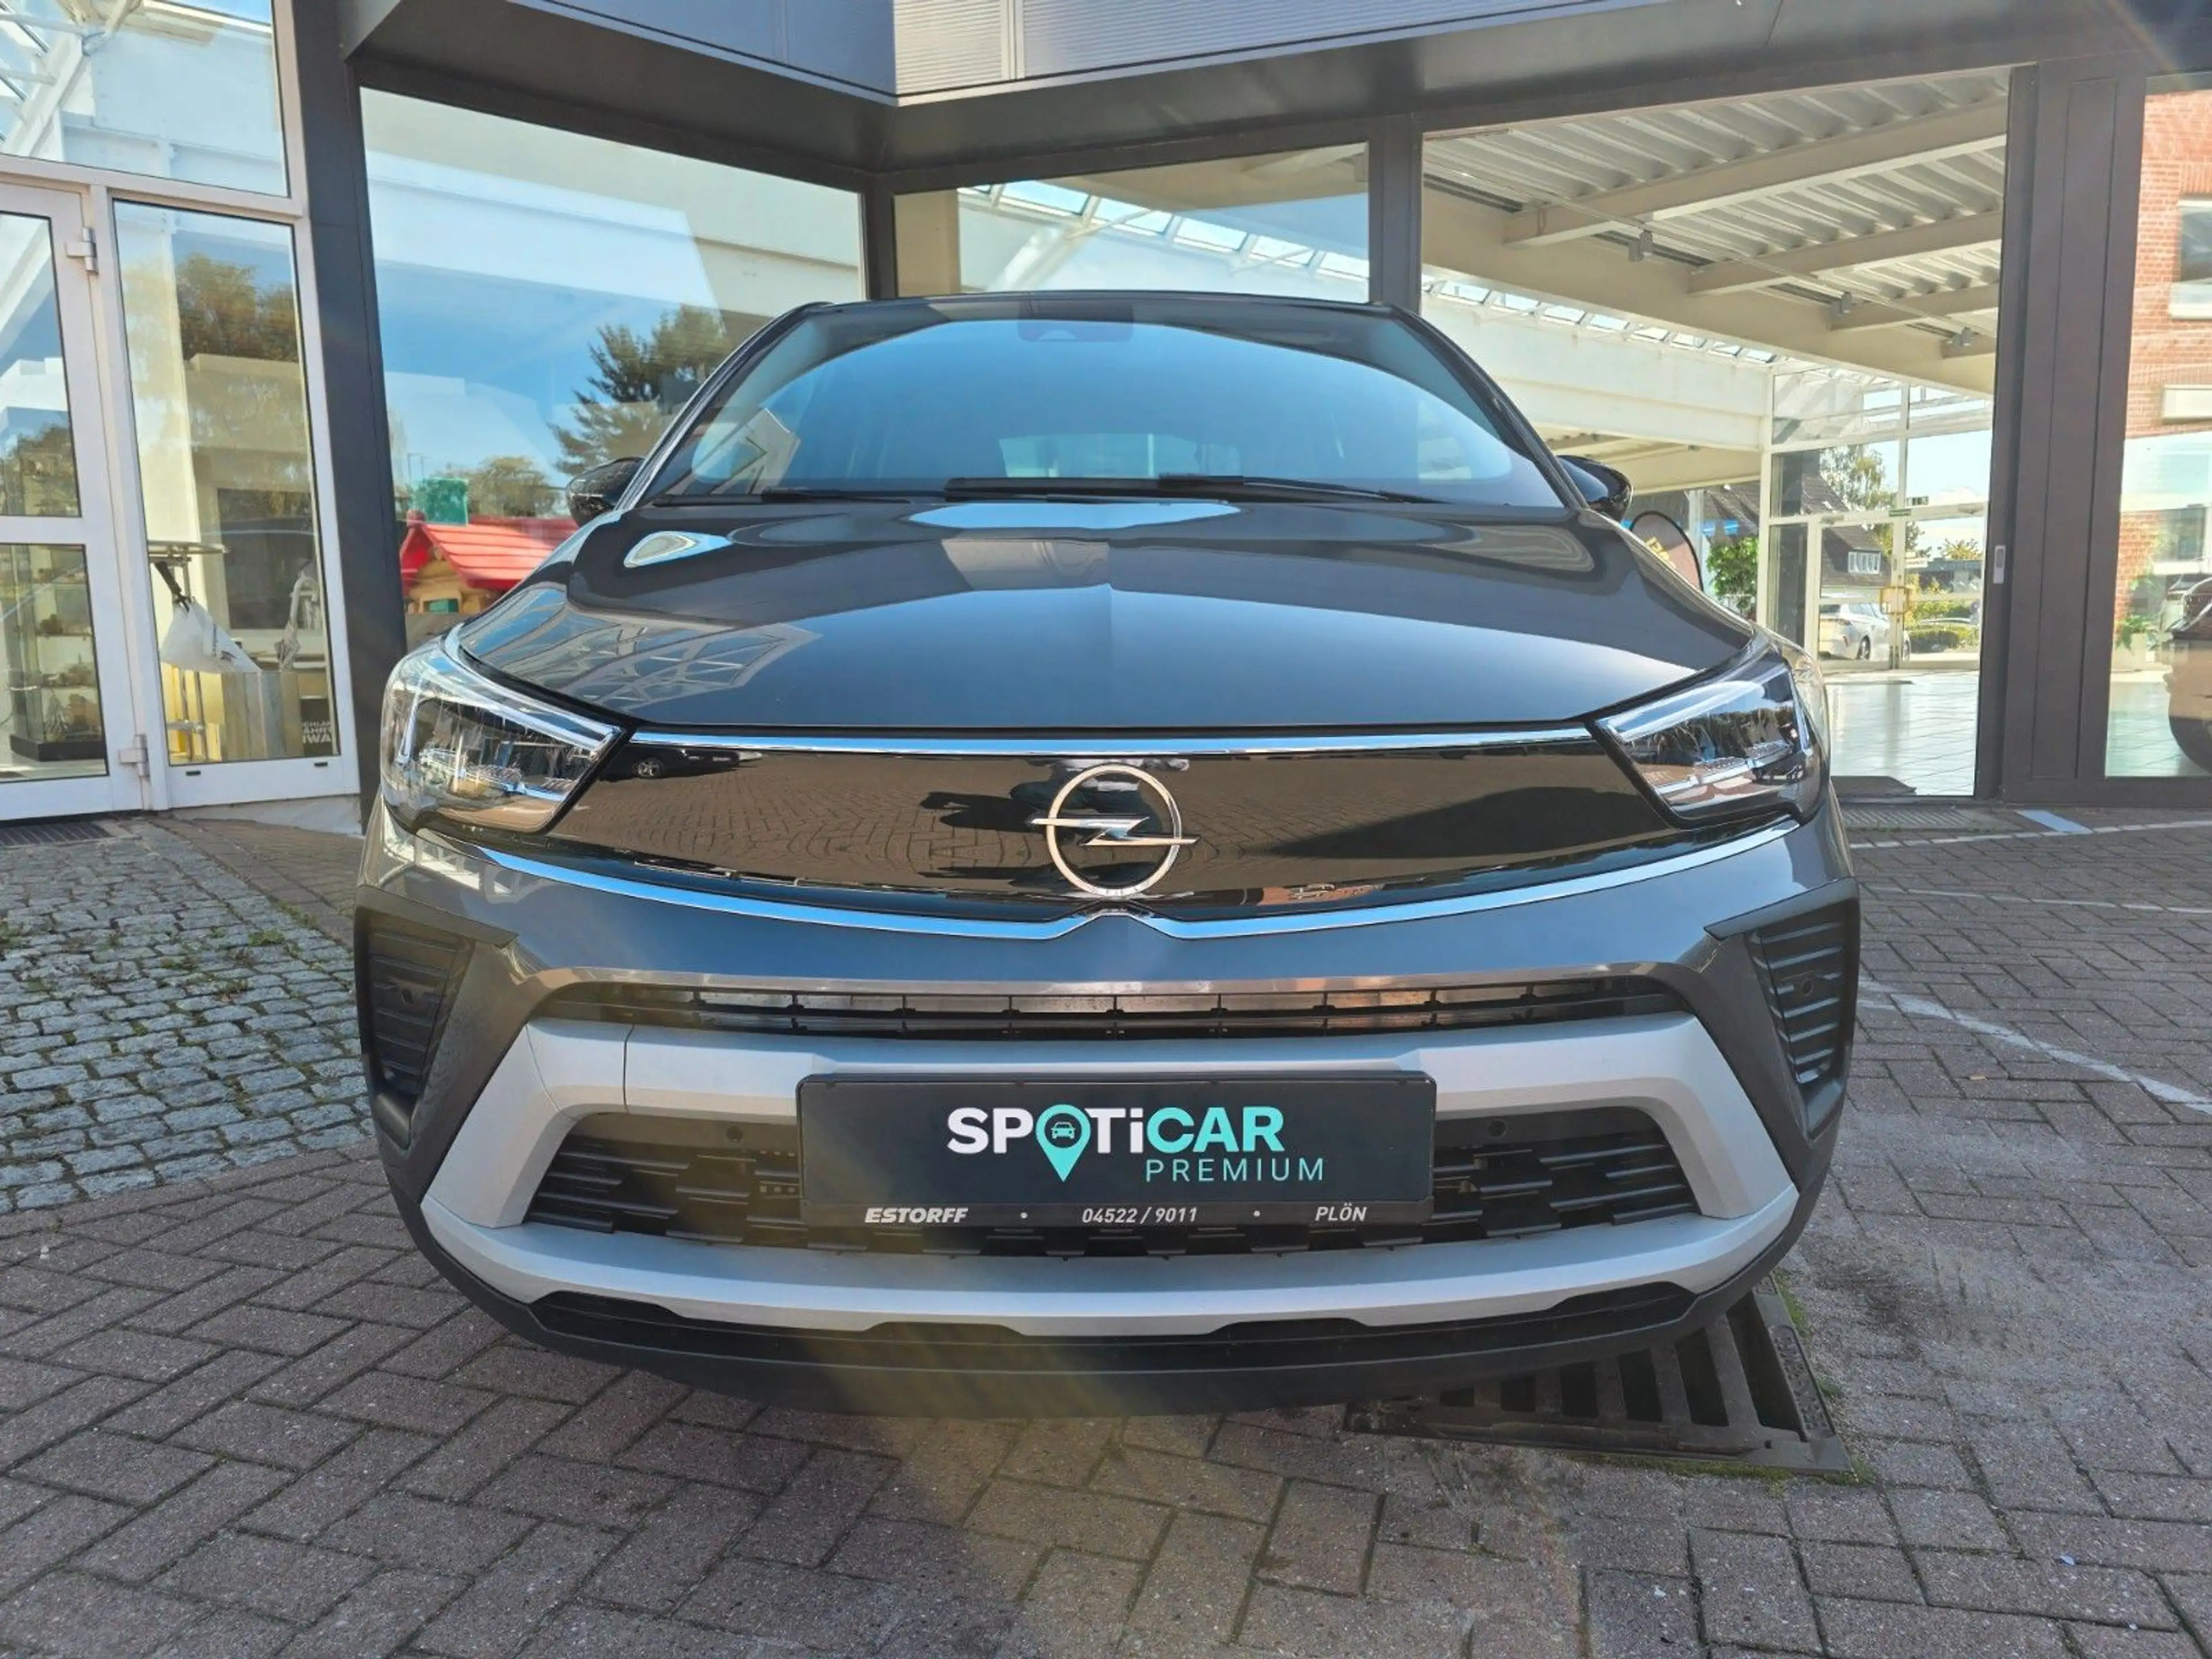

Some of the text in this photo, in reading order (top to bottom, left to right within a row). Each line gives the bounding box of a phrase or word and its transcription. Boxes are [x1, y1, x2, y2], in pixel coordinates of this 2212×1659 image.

[1146, 1158, 1324, 1182] PREMIUM
[865, 1207, 969, 1224] ESTORFF
[1315, 1202, 1367, 1221] PLÖN
